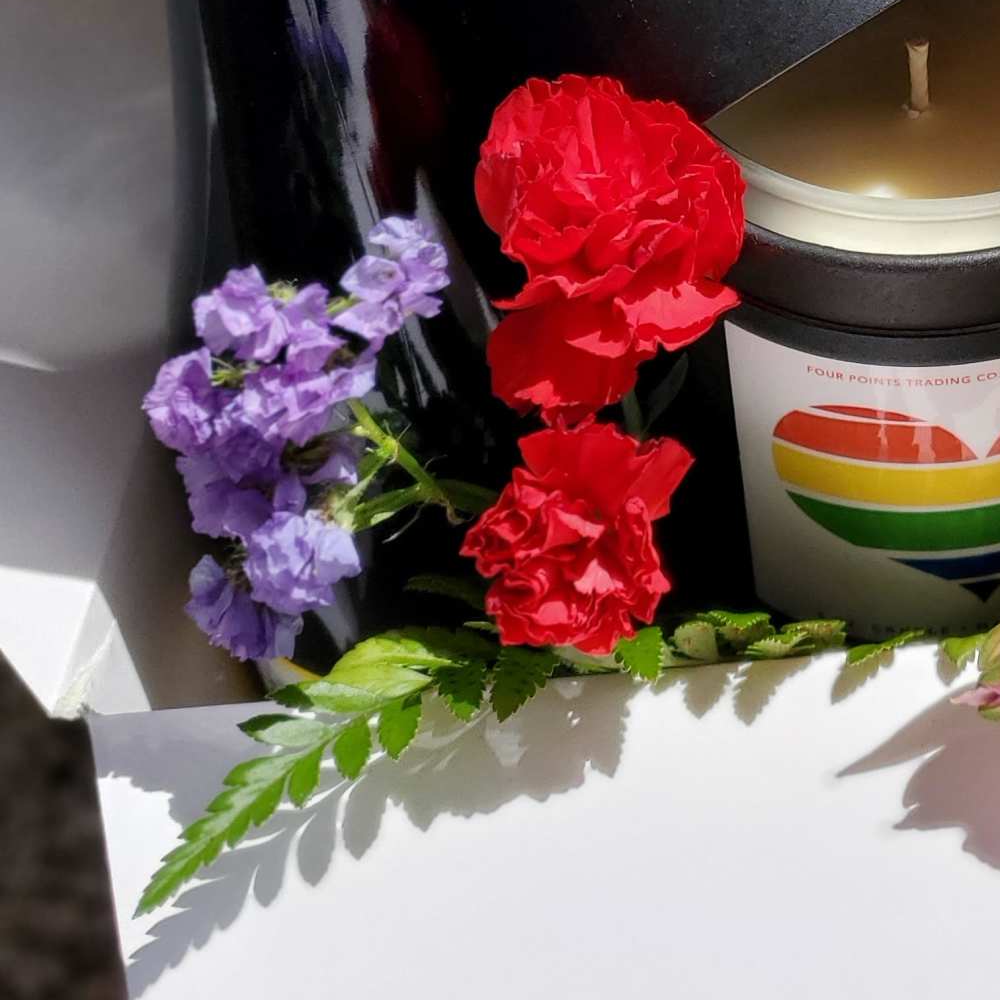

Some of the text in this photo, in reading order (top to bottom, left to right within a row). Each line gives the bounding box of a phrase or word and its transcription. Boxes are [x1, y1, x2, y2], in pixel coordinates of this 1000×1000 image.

[806, 364, 844, 380] FOUR
[849, 374, 901, 387] POINTS
[906, 375, 971, 387] TRADING
